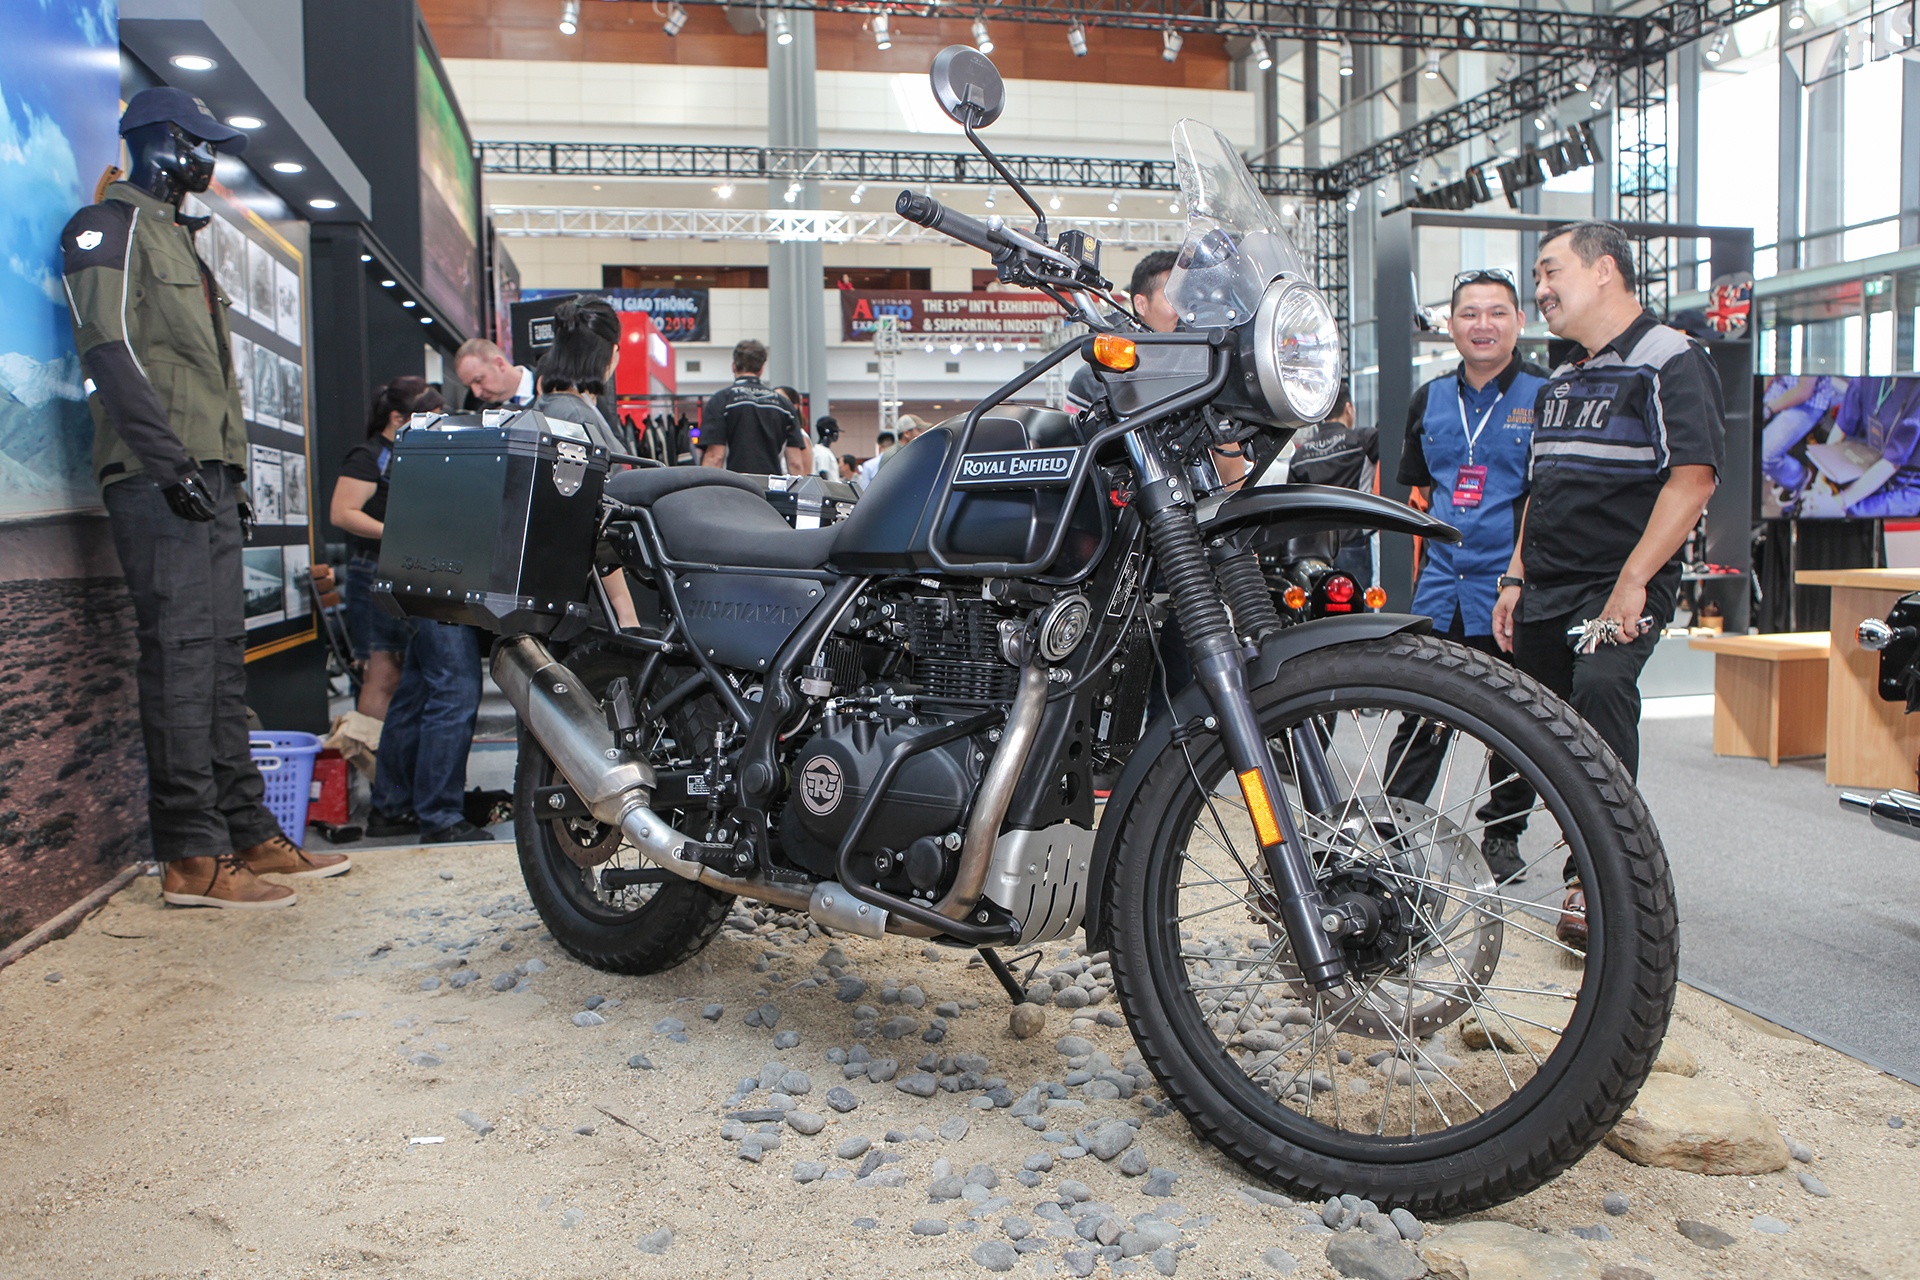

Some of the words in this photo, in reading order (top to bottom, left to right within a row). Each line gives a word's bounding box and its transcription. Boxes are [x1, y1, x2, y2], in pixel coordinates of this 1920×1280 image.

[624, 297, 653, 311] GIAO
[922, 298, 944, 313] THE
[998, 299, 1058, 314] EXHIBITION
[665, 317, 695, 331] 2018
[922, 319, 932, 331] &
[934, 319, 1001, 332] SUPPORTING
[1304, 433, 1346, 450] TRIUMPH
[963, 460, 1006, 476] ROYAL
[1009, 457, 1068, 475] ENFIELD
[1345, 1136, 1509, 1186] PIRELLI
